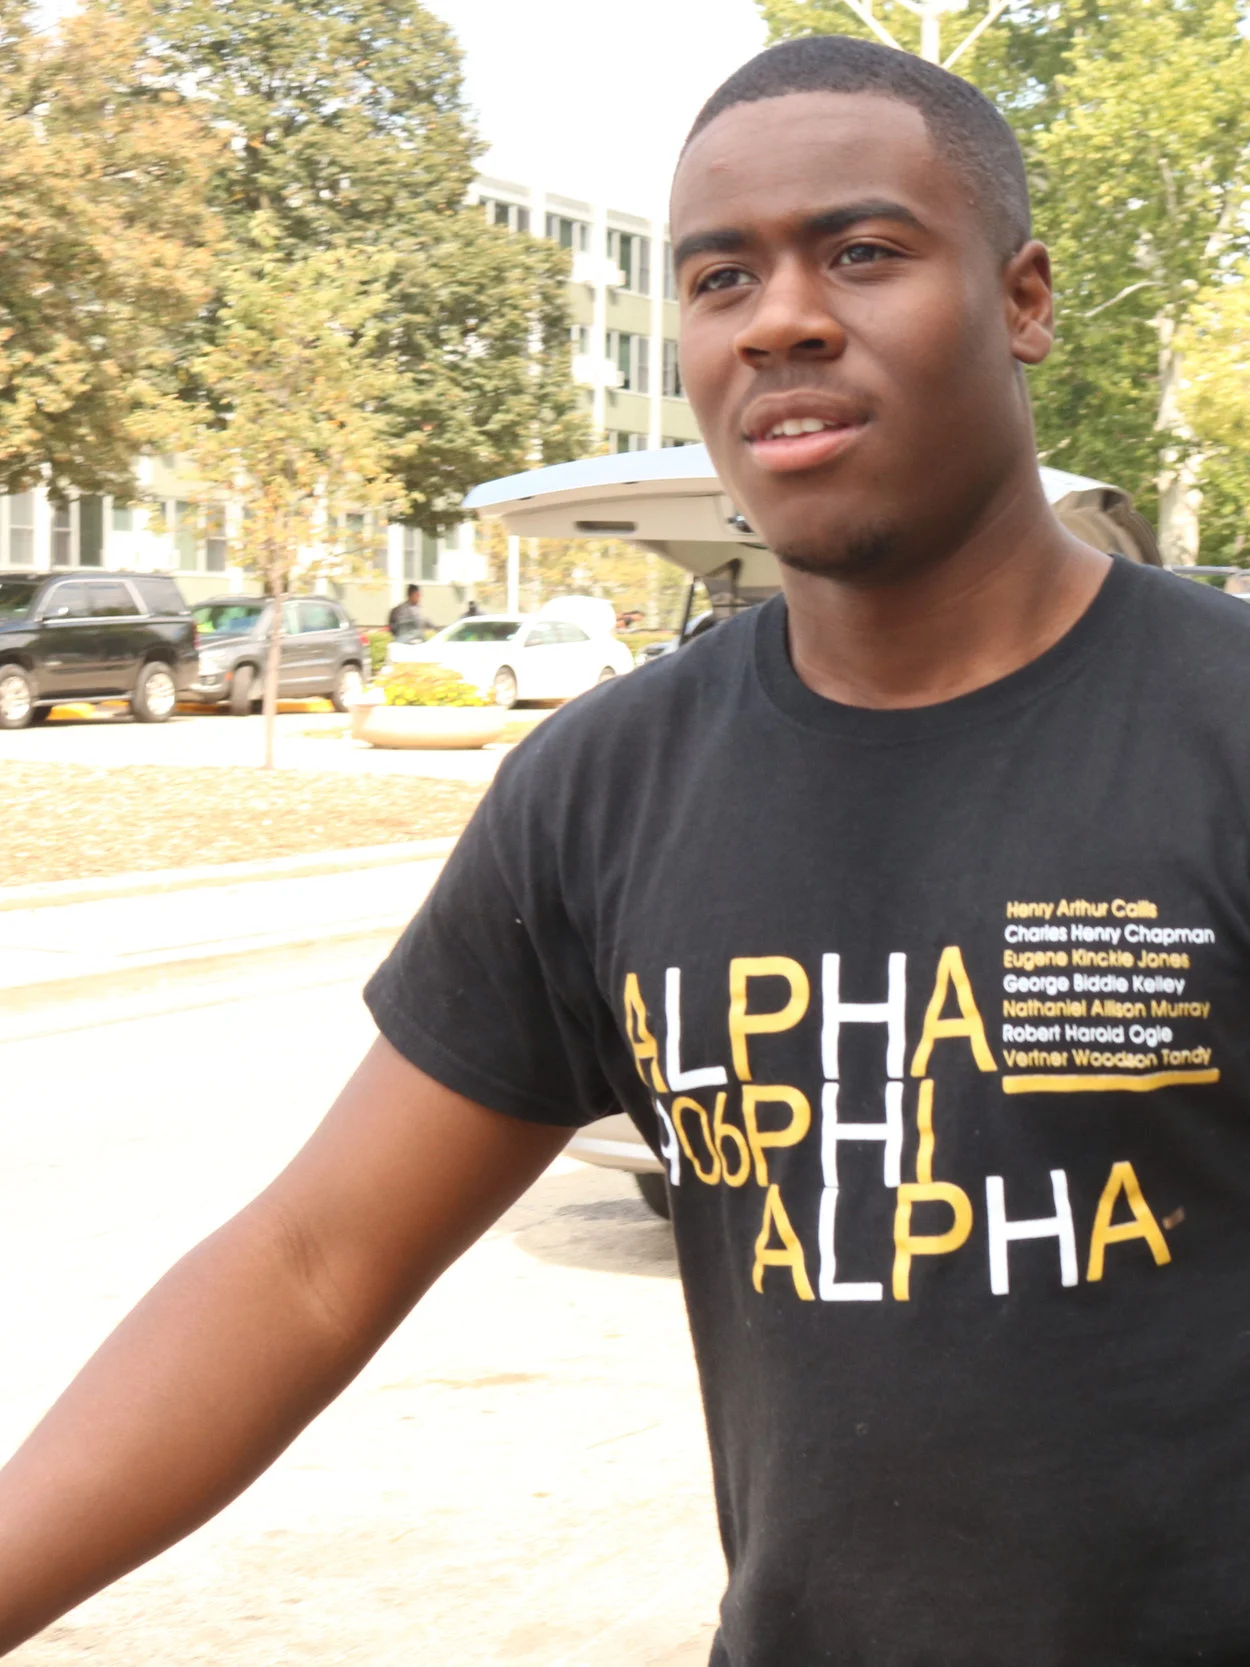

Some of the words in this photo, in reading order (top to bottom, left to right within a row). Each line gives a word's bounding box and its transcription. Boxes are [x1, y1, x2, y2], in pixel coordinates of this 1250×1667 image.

[1006, 900, 1054, 920] Henry
[1056, 899, 1109, 918] Arthur
[1111, 898, 1158, 919] Callis
[1004, 924, 1068, 943] Charles
[1070, 923, 1121, 945] Henry
[1124, 923, 1215, 946] Chapman
[1003, 949, 1069, 971] Eugene
[1072, 948, 1134, 968] Kinckle
[1137, 951, 1190, 969] Jones
[1003, 974, 1070, 996] George
[1073, 973, 1129, 993] Biddle
[1132, 975, 1185, 996] Kelley
[624, 946, 998, 1093] ALPHA
[1003, 999, 1087, 1018] Nathaniel
[1090, 999, 1147, 1019] Allison
[1151, 1000, 1210, 1019] Murray
[1002, 1024, 1061, 1043] Robert
[1065, 1024, 1125, 1044] Harold
[1129, 1024, 1173, 1047] Ogle
[1003, 1049, 1069, 1068] Vertner
[1072, 1049, 1157, 1068] Woodson
[1162, 1046, 1211, 1066] Tandy
[742, 1079, 934, 1188] PHI
[752, 1161, 1171, 1301] ALPHA
